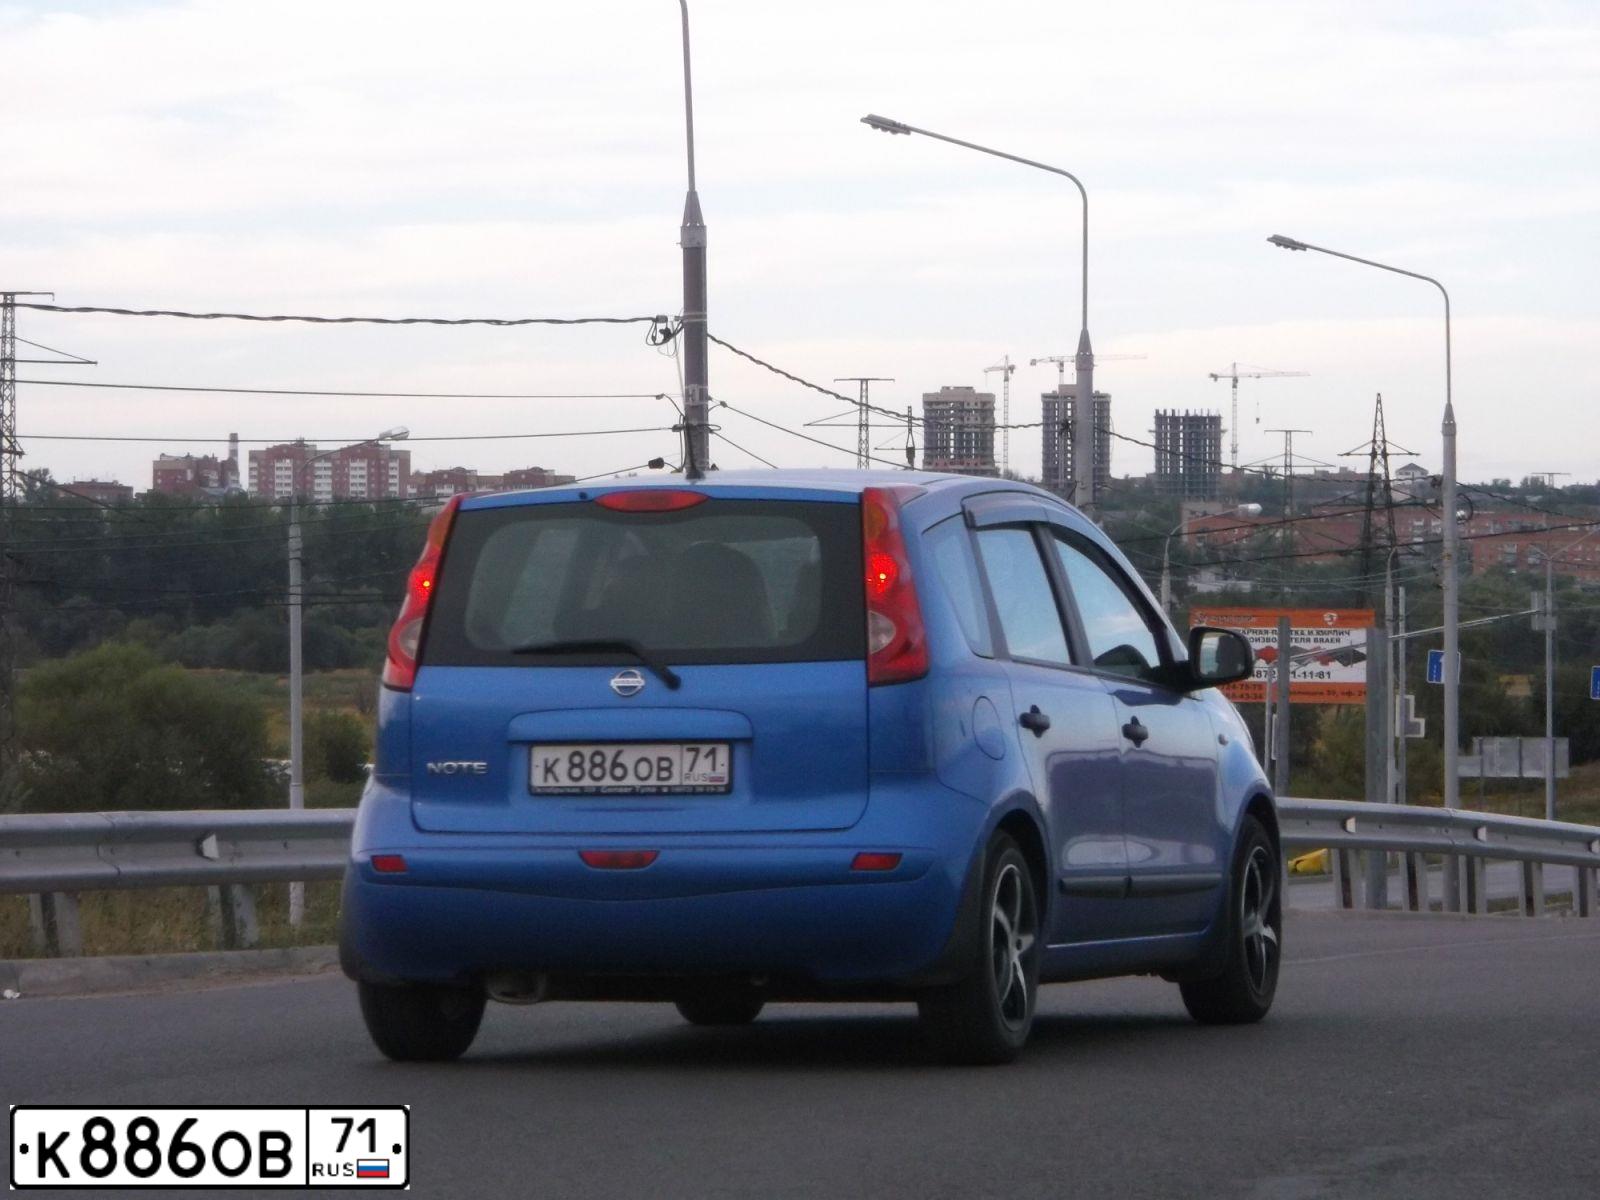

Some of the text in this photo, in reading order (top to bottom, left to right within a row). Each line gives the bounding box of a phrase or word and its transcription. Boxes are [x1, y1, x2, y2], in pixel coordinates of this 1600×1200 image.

[685, 747, 717, 772] 71
[426, 761, 488, 775] NOTE
[684, 773, 708, 783] RUS
